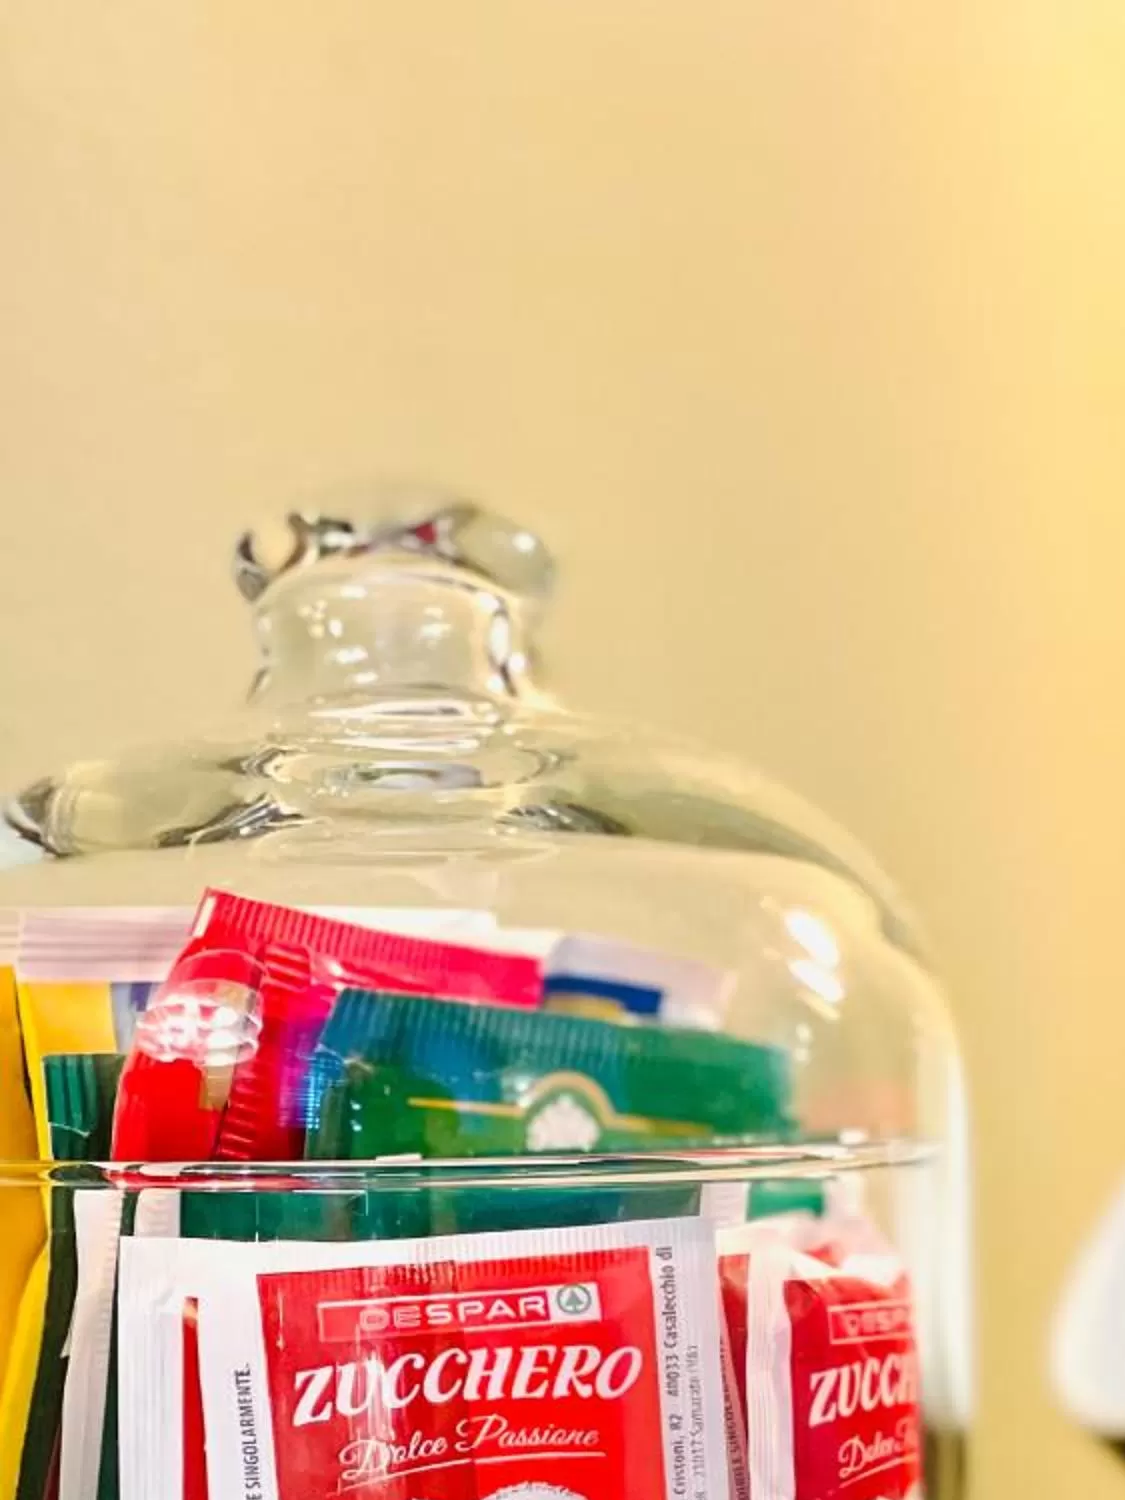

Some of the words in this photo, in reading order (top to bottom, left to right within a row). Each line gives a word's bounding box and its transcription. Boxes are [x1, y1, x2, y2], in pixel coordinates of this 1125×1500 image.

[656, 1246, 672, 1261] di
[359, 1294, 546, 1333] DESPAR
[660, 1265, 678, 1349] Casalecchio
[292, 1344, 644, 1428] ZUCCHERO
[233, 1363, 262, 1489] SINGOLARMENTE.
[338, 1430, 447, 1480] Dolce
[454, 1413, 600, 1453] Passione
[671, 1436, 687, 1495] Cristoni,
